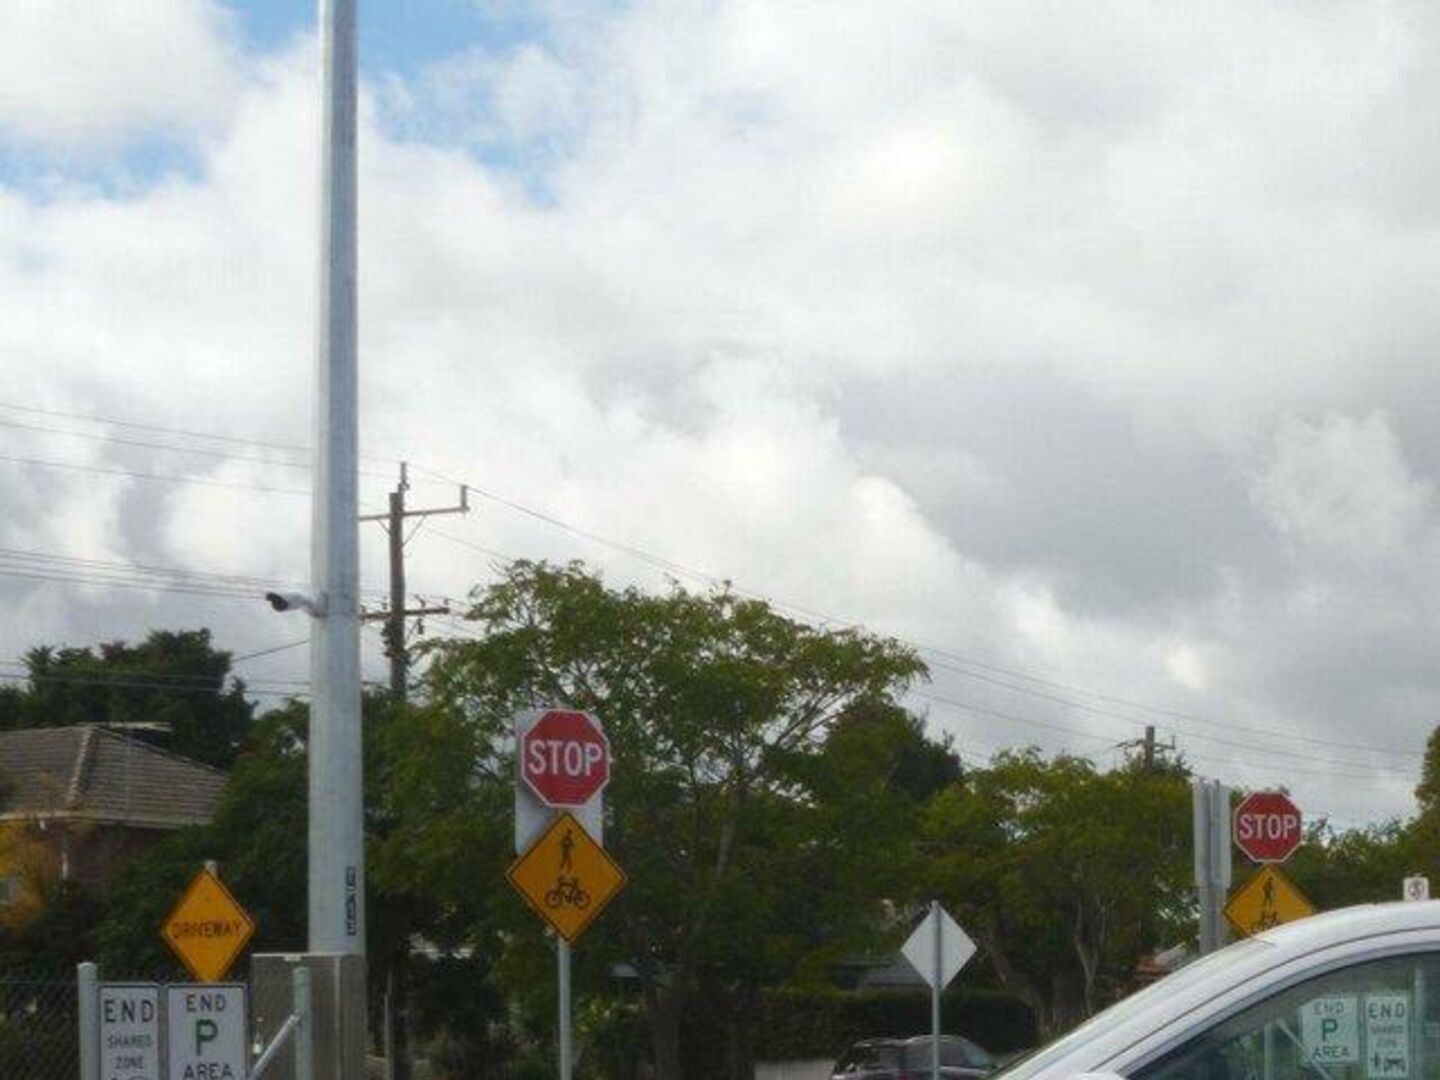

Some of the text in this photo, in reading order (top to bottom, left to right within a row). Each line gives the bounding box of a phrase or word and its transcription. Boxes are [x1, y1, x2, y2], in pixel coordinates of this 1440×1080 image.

[528, 739, 603, 777] STOP
[1239, 813, 1297, 840] STOP
[171, 921, 242, 938] DRIVEWAY
[104, 1000, 154, 1023] END
[186, 994, 226, 1012] END
[1313, 1001, 1345, 1016] END
[1367, 1002, 1406, 1019] END
[195, 1018, 219, 1057] P
[1322, 1018, 1339, 1042] P
[107, 1034, 154, 1049] SHARED
[1312, 1045, 1351, 1060] AREA
[114, 1056, 145, 1070] ZONE
[183, 1063, 233, 1080] AREA
